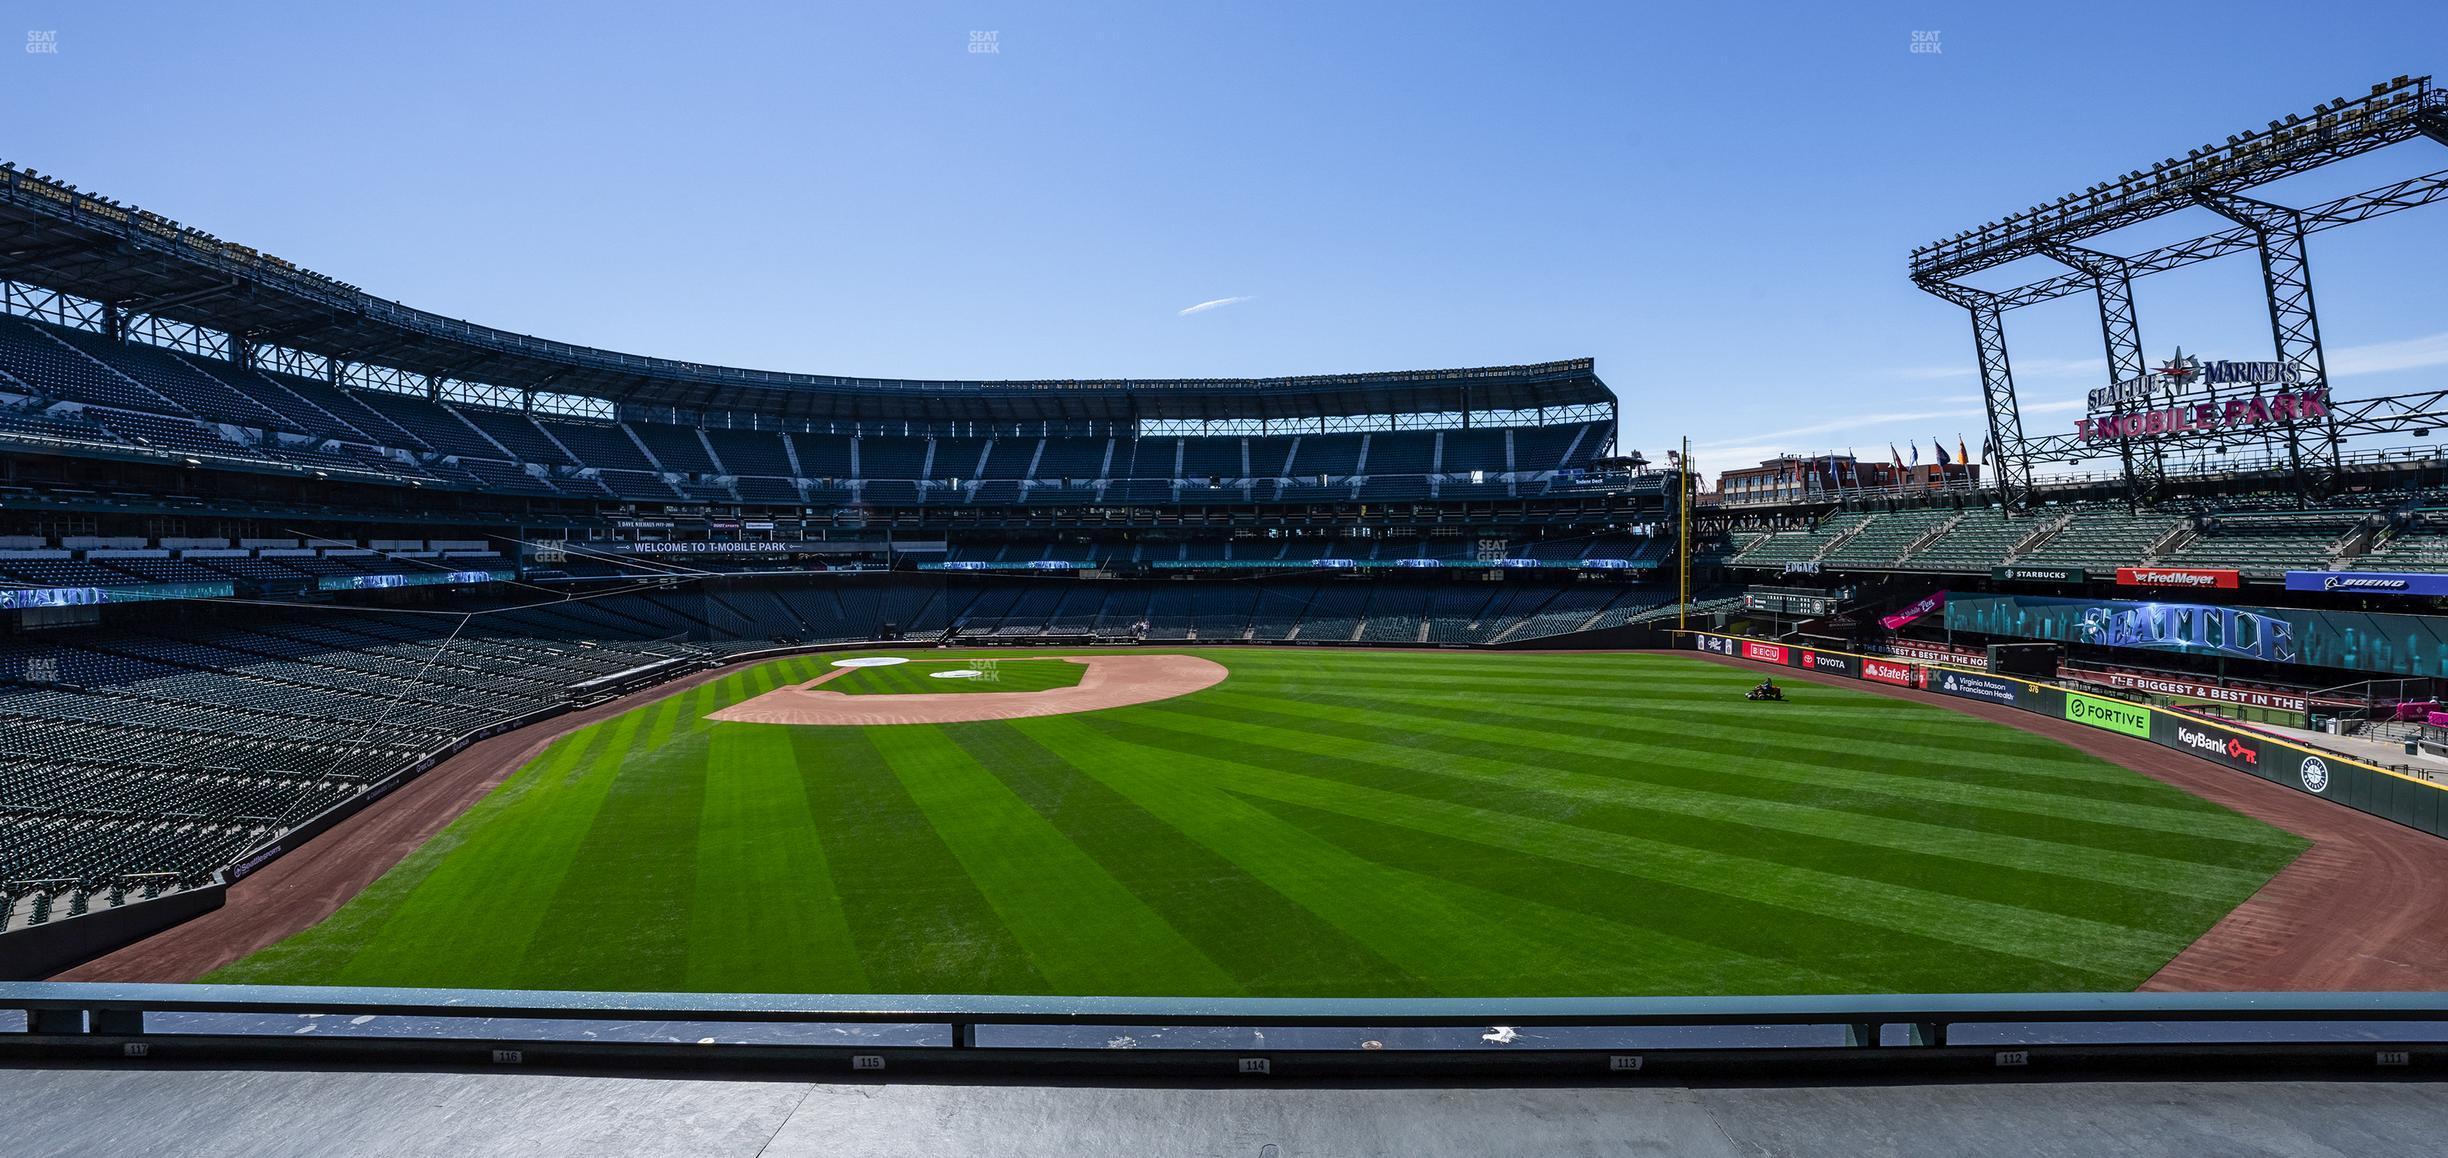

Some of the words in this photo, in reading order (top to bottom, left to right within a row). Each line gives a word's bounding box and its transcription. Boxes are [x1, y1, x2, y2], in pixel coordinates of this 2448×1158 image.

[2203, 360, 2300, 384] MARINERS
[2088, 375, 2160, 411] SEATTLE
[2074, 402, 2218, 442] T-MOBILE
[2225, 386, 2332, 427] PARK
[634, 543, 687, 552] WELCOME
[691, 543, 705, 551] TO
[709, 542, 756, 551] T-MOBILE
[759, 542, 786, 551] PARK
[2016, 570, 2066, 579] STARBUCKS
[2342, 578, 2406, 588] BOEING
[1816, 656, 1845, 669] TOYOTA
[1918, 651, 1939, 661] BEST
[1941, 654, 1950, 662] IN
[1951, 655, 1968, 664] THE
[1959, 677, 1984, 688] Virginia
[1984, 680, 2006, 691] Mason
[2028, 684, 2039, 694] 376
[1959, 684, 1993, 697] Franciscan
[1994, 689, 2014, 700] Health
[2110, 675, 2135, 687] THE
[2138, 677, 2191, 694] BIGGEST
[2196, 687, 2206, 697] &
[2210, 688, 2252, 702] BEST
[2252, 694, 2268, 704] IN
[2272, 697, 2305, 710] THE
[2088, 704, 2144, 729] FORTIVE
[2178, 726, 2227, 756] KeyBank
[130, 1044, 147, 1055] 117
[500, 1052, 517, 1062] 116
[861, 1058, 880, 1067] 115
[2003, 1053, 2022, 1064] 112
[2383, 1054, 2402, 1064] 111
[1246, 1060, 1265, 1070] 114
[1617, 1058, 1636, 1068] 113
